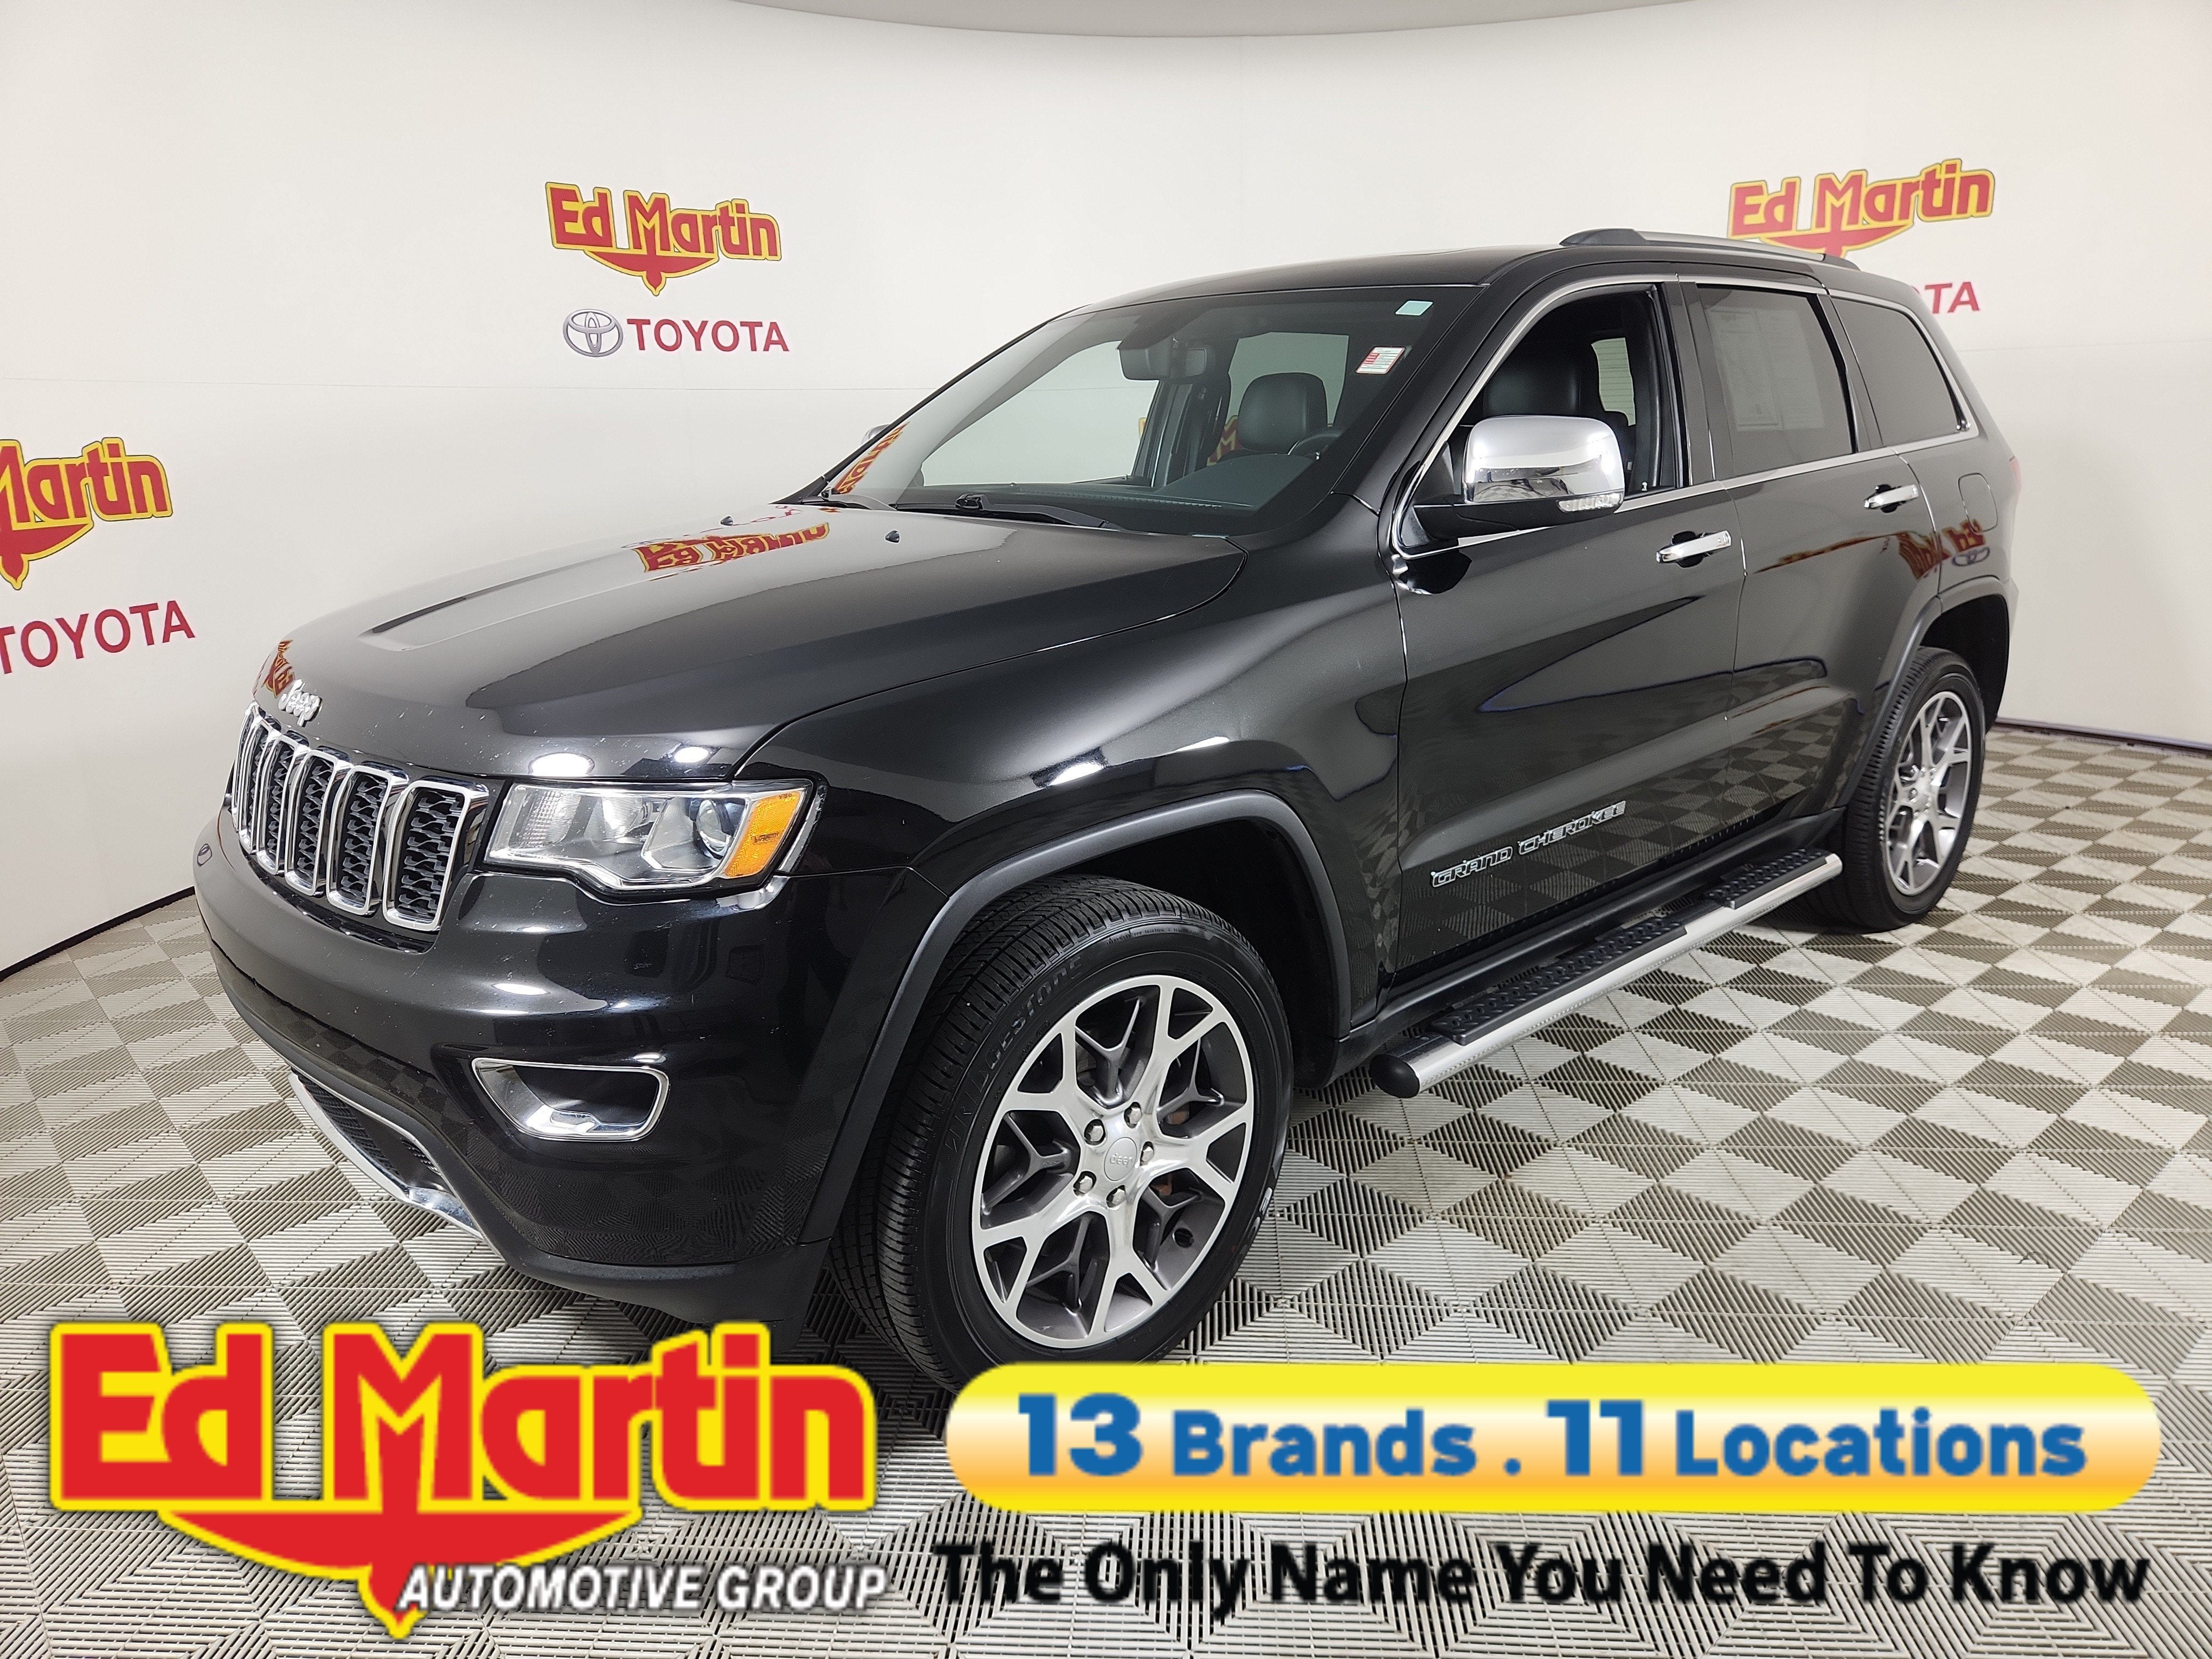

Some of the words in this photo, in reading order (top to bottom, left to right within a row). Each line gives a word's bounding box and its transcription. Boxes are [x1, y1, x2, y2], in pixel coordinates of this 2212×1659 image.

[547, 184, 616, 249] Ed
[625, 191, 780, 259] Martin
[1729, 178, 1799, 238] Ed
[1814, 160, 1993, 228] Martin
[626, 318, 790, 352] TOYOTA
[1431, 846, 1513, 888] GRAND
[1519, 800, 1626, 855] CHEROKEE
